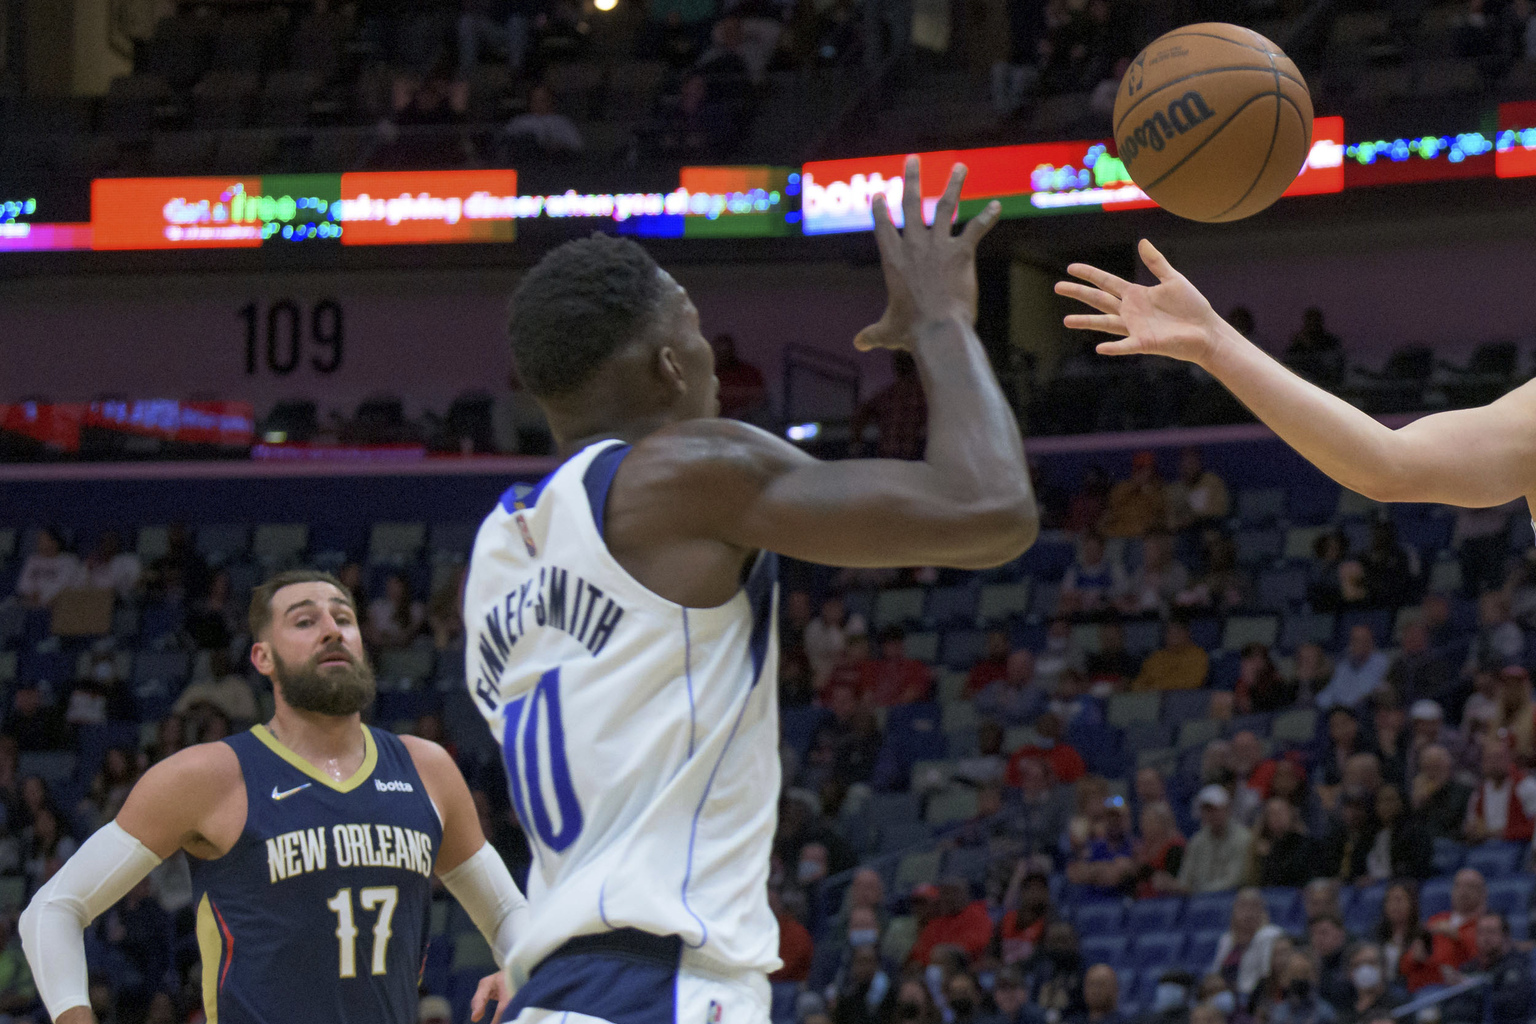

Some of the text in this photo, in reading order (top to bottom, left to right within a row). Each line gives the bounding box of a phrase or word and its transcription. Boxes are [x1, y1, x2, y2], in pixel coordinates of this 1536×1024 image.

[236, 298, 346, 376] 109
[374, 778, 414, 793] ibotta
[265, 823, 433, 884] NEW ORLEANS
[326, 885, 399, 979] 17
